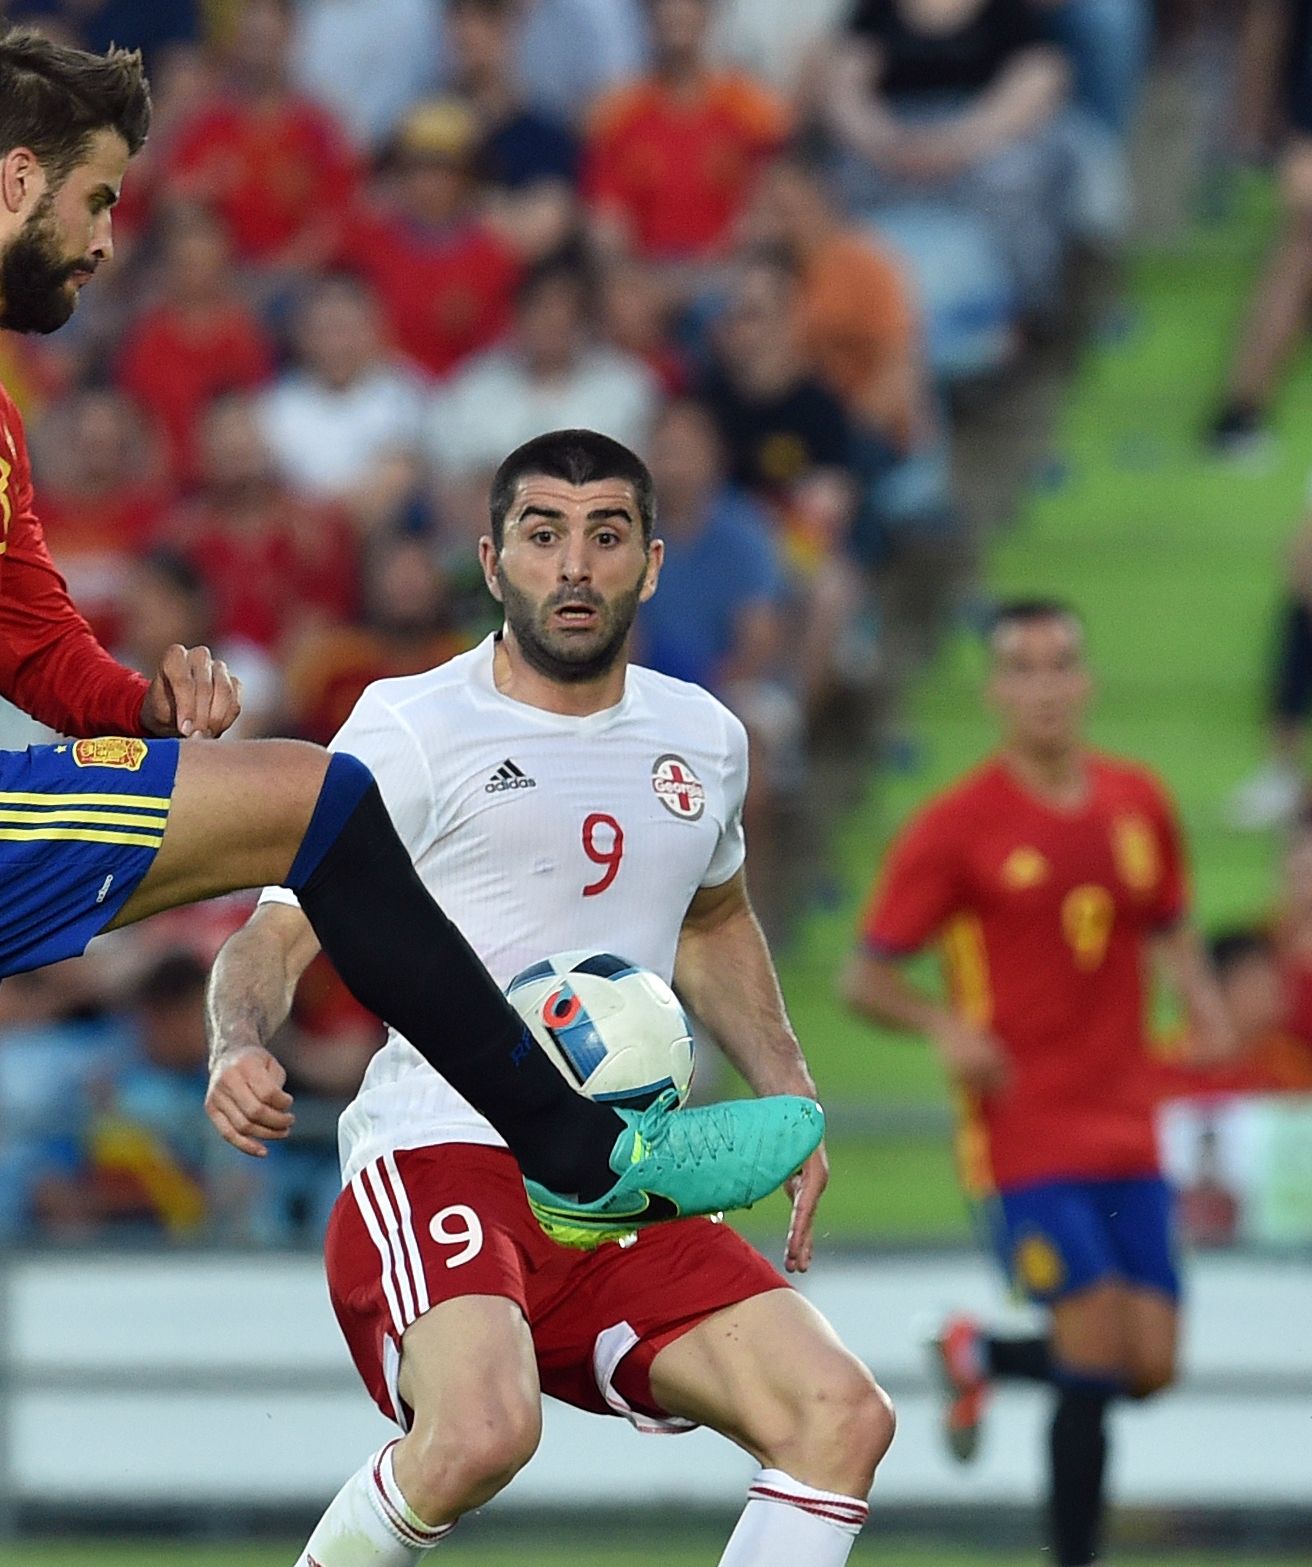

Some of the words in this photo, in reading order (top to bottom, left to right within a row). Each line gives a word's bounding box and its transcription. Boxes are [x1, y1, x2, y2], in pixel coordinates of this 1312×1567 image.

[485, 777, 536, 793] adidas
[653, 779, 704, 799] Georgia
[582, 813, 623, 896] 9
[429, 1204, 483, 1269] 9
